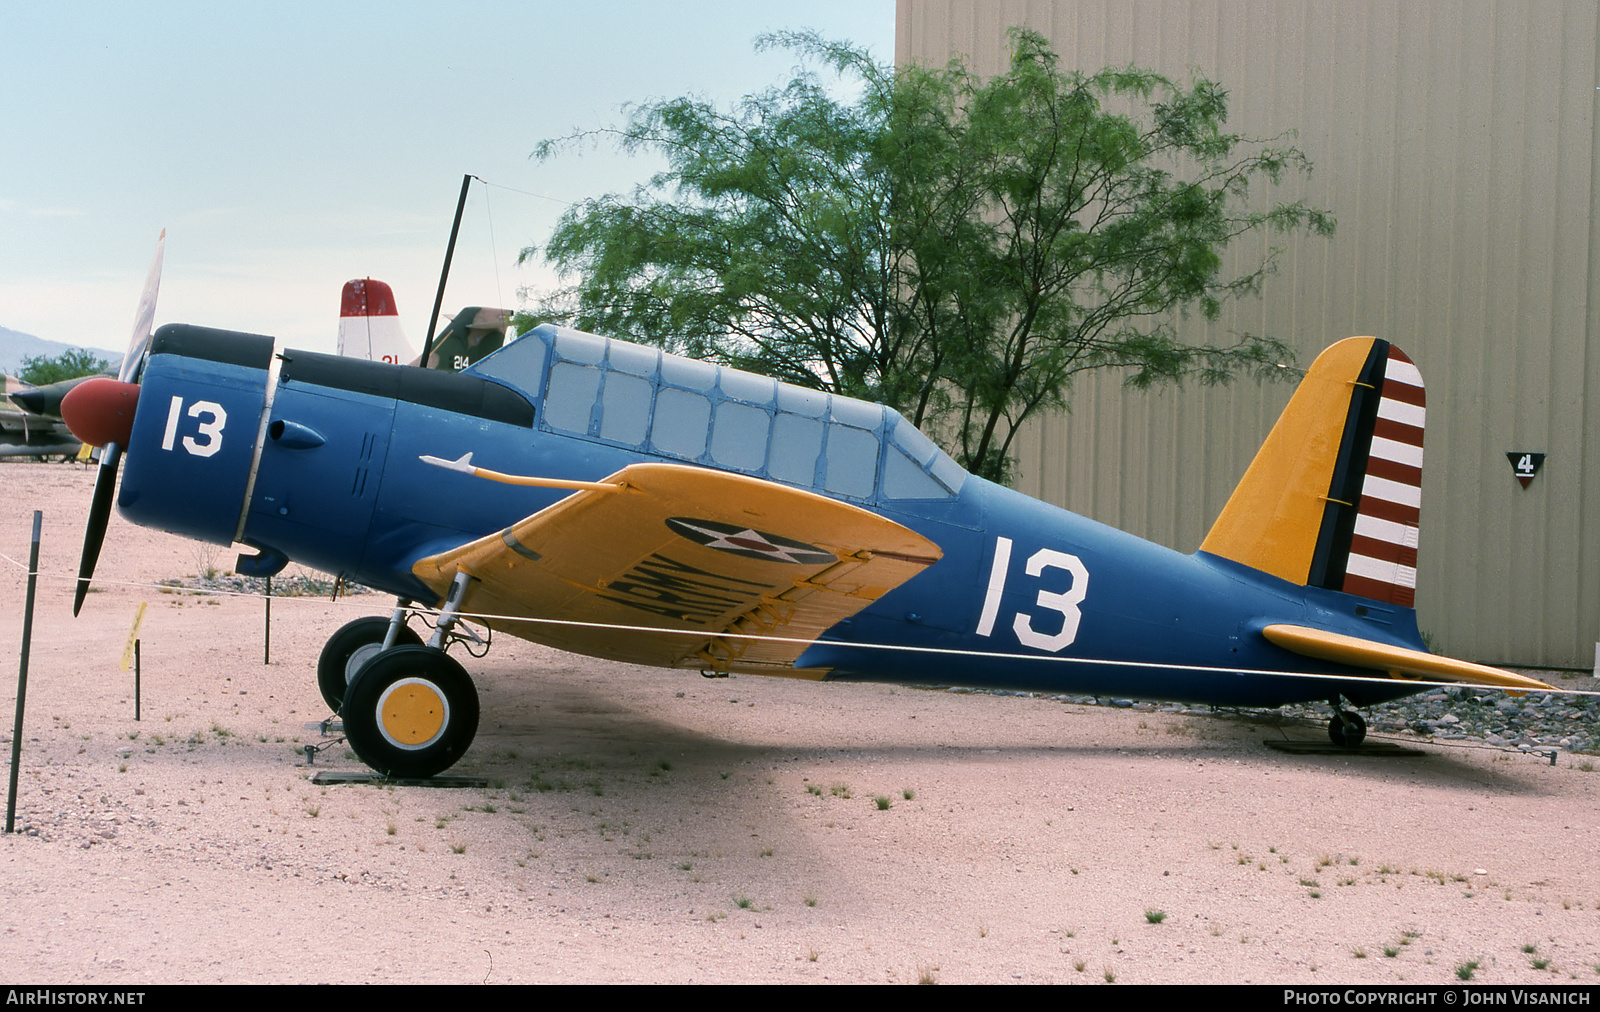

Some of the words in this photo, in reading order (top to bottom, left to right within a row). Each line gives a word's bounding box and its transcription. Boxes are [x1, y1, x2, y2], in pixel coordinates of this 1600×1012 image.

[454, 355, 469, 369] 214
[162, 395, 227, 457] 13
[1517, 454, 1534, 473] 4
[595, 553, 776, 624] ARMY
[976, 536, 1089, 652] 13
